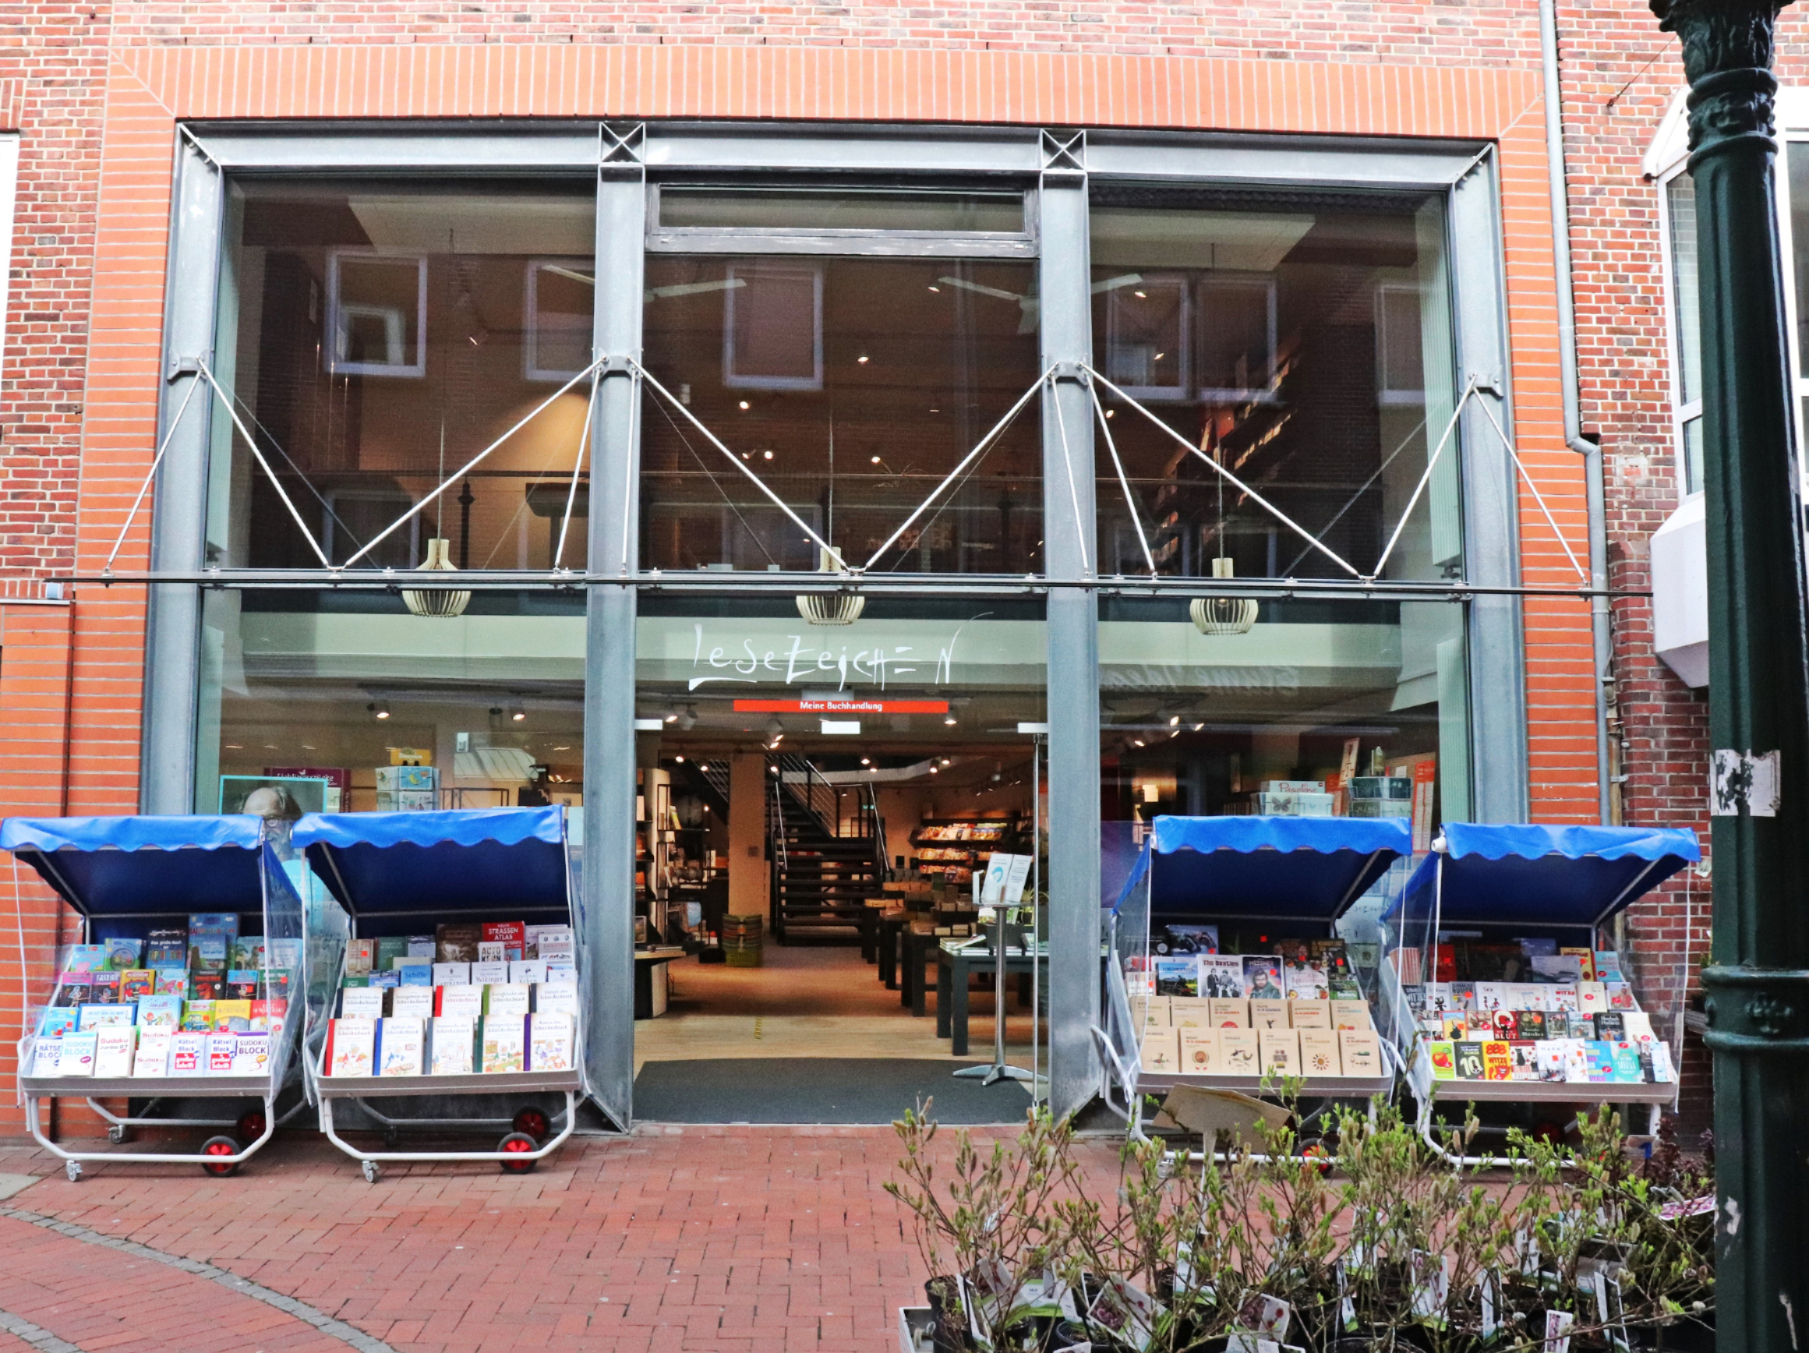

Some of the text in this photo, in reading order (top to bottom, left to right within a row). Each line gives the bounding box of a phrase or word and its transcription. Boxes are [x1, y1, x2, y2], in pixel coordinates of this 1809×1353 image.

[800, 701, 883, 712] Meine Buchhandlung
[488, 927, 519, 935] STRASSEN
[39, 1043, 62, 1051] RÄTSE
[239, 1046, 266, 1054] BLOCK
[1486, 1043, 1507, 1055] 888
